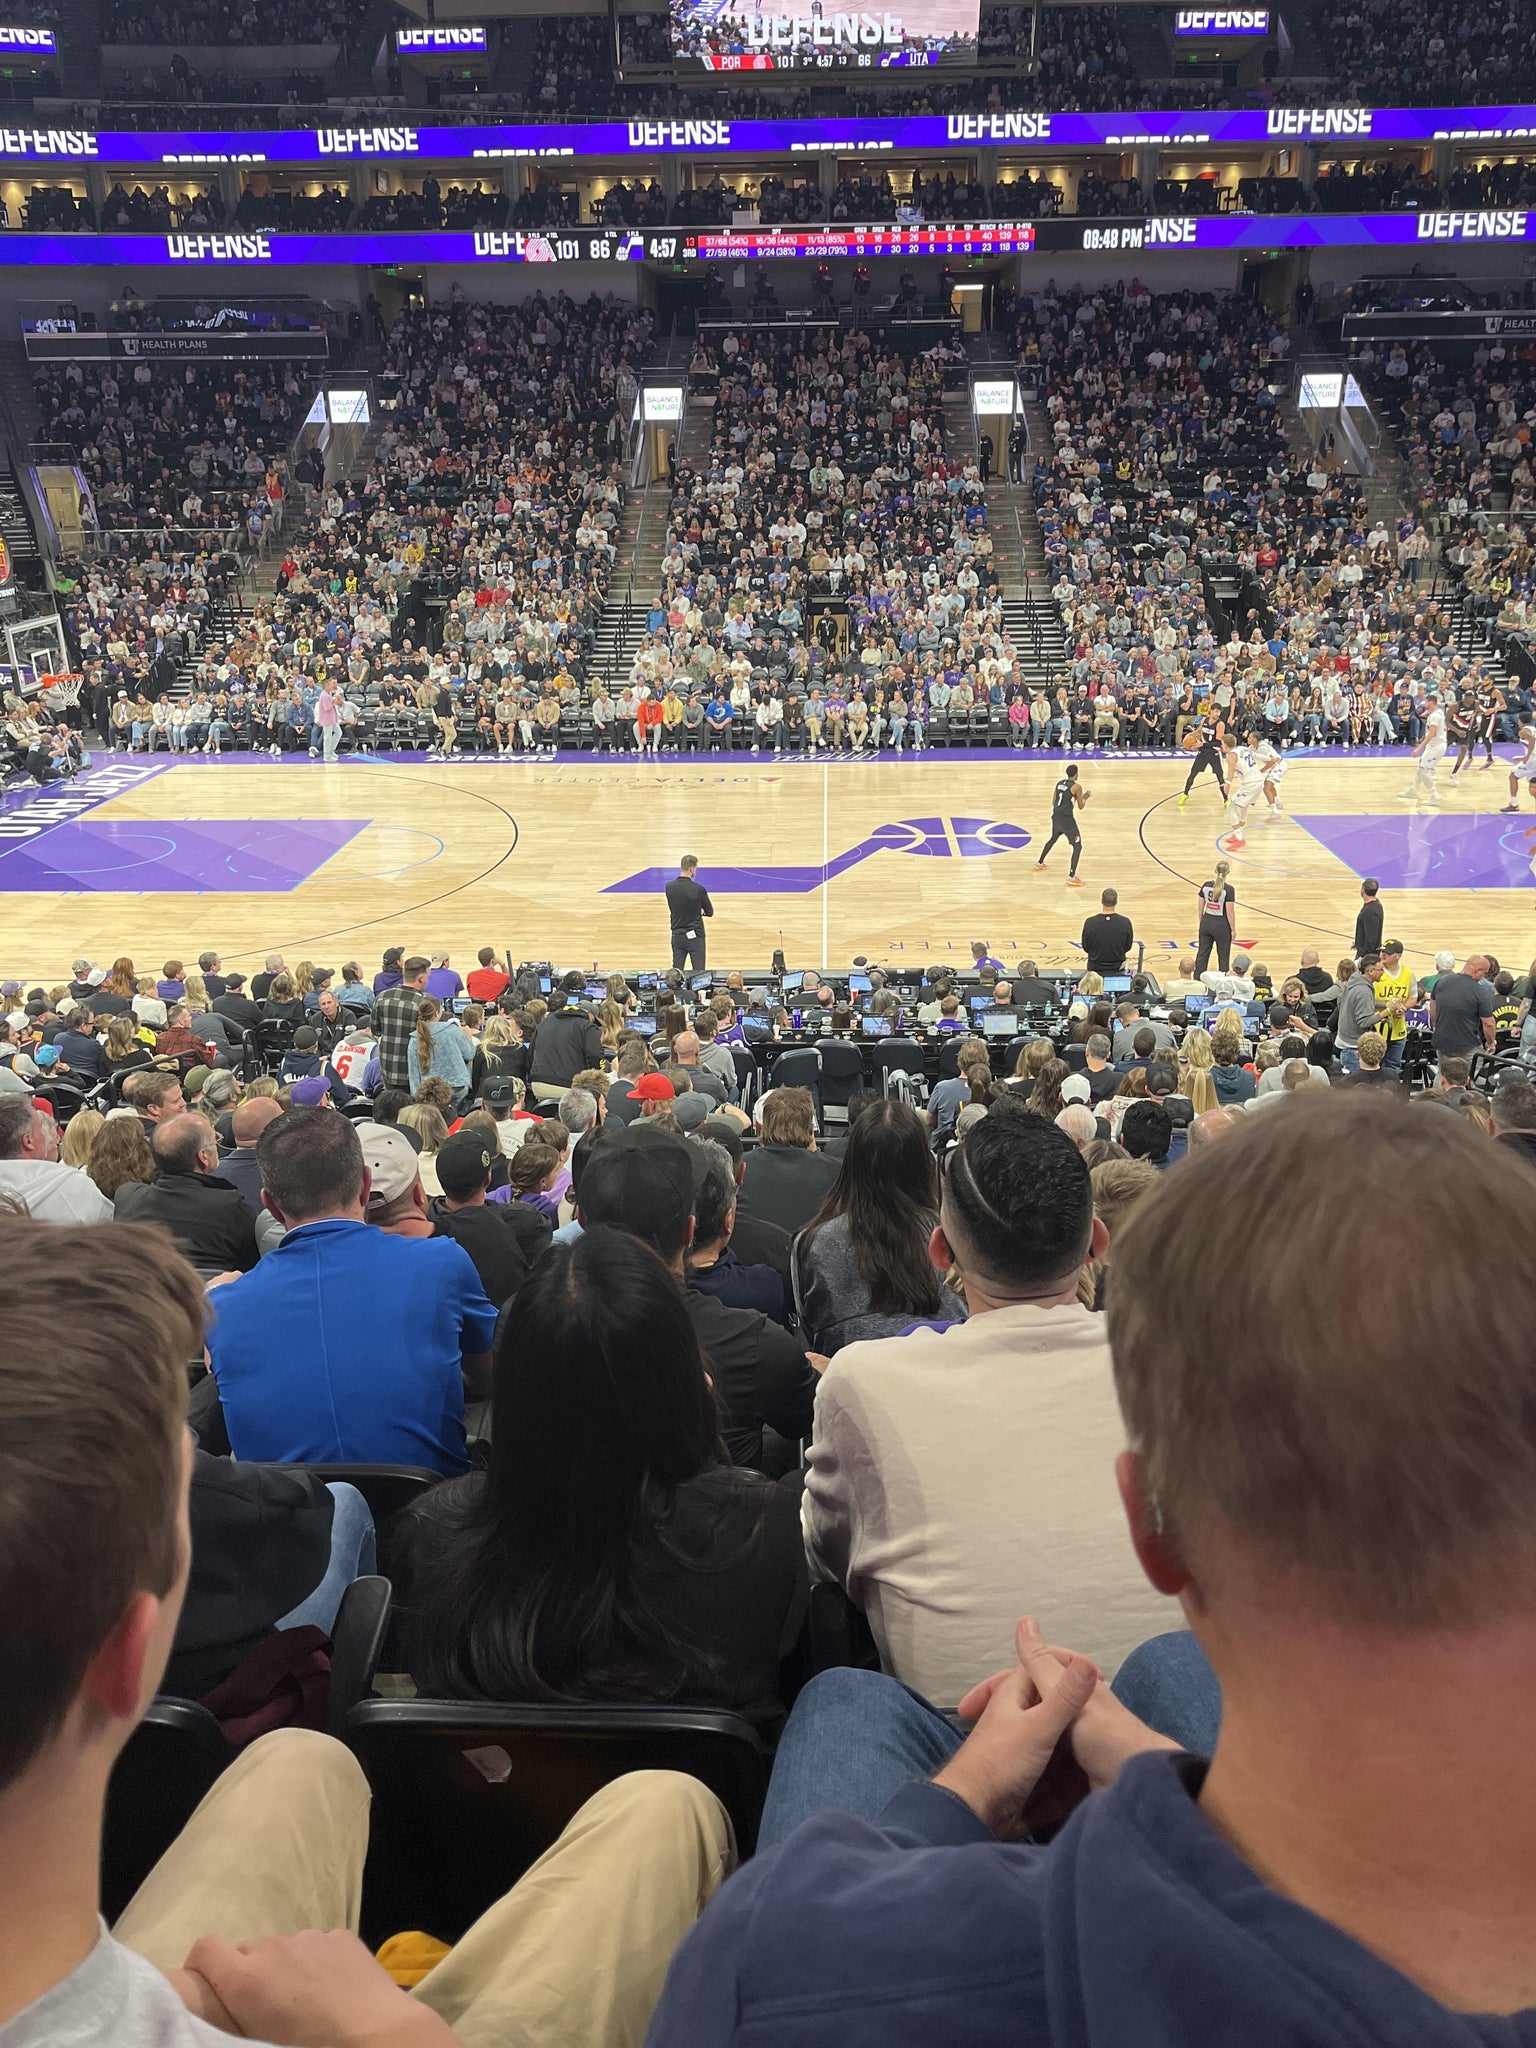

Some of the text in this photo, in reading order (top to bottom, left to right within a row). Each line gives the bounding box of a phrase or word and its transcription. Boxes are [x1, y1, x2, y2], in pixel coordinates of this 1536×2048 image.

[1178, 11, 1267, 28] DEFENSE
[746, 11, 903, 45] DEFENSE
[398, 28, 484, 45] DEFENSE
[721, 57, 741, 68] POR
[777, 56, 795, 68] 101
[816, 55, 833, 67] 4:57
[838, 57, 847, 65] 13
[858, 55, 871, 67] 86
[909, 54, 929, 65] UTA
[948, 113, 1051, 138] DEFENSE
[1267, 109, 1373, 134] DEFENSE
[317, 128, 419, 153] DEFENSE
[628, 119, 731, 146] DEFENSE
[1417, 212, 1528, 238] DEFENSE
[685, 237, 695, 247] 13
[706, 236, 728, 246] 37/68
[729, 236, 749, 246] (54%)
[777, 235, 797, 245] (44%)
[808, 235, 825, 245] 11/13
[856, 235, 865, 243] 10
[982, 231, 993, 239] 40
[999, 231, 1012, 240] 139
[1082, 228, 1143, 250] 08:48 PM
[168, 236, 272, 259] DEFENSE
[556, 240, 580, 259] 101
[590, 240, 610, 259] 86
[650, 238, 677, 258] 4:57
[682, 249, 697, 258] 3RD
[706, 241, 1030, 257] 27/59 (46%) 9/24 (38%) 23/29 (79%) 13 17 30 20 5 3 13 23 118 139
[142, 340, 176, 349] HEALTH
[178, 340, 208, 349] PLANS
[425, 754, 557, 762] SEATGEEK
[1057, 792, 1063, 807] 1
[0, 798, 101, 838] UTAH
[1379, 986, 1407, 997] JAZZ
[337, 1045, 366, 1055] CLARKSON
[336, 1055, 352, 1080] 6
